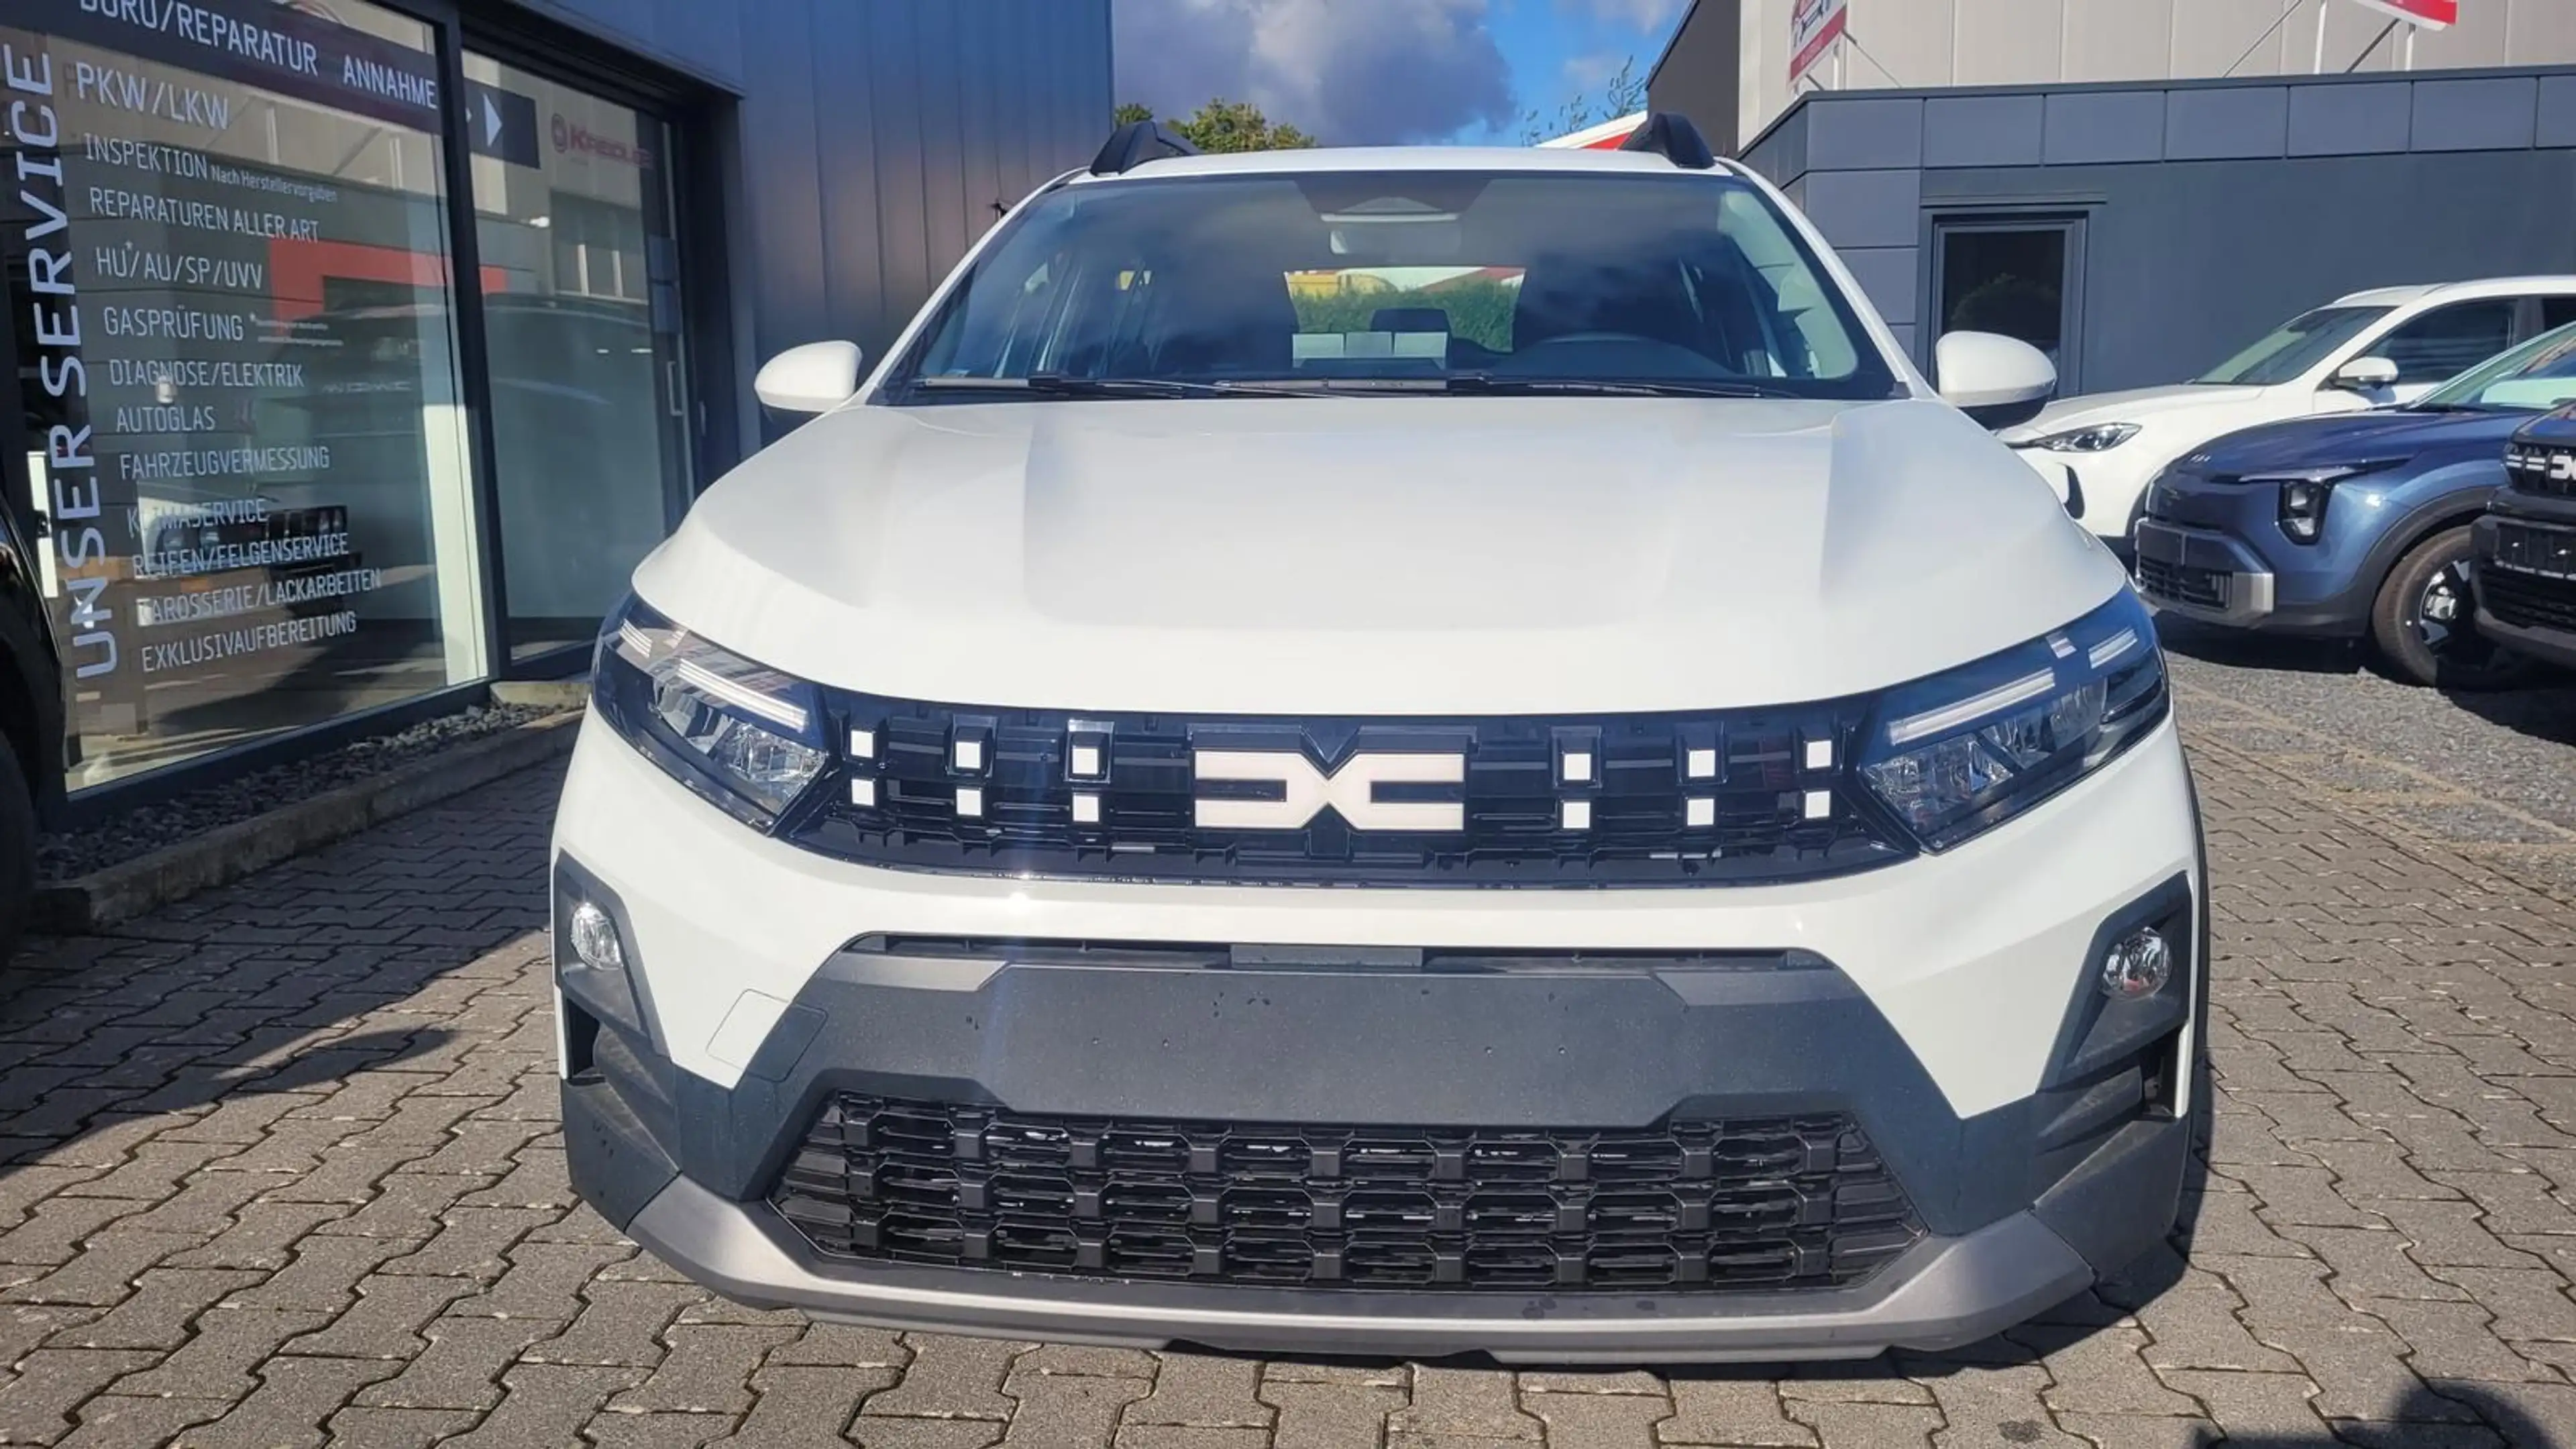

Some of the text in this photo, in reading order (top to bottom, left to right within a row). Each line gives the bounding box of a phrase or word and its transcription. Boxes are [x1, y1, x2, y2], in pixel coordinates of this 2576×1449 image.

[76, 61, 229, 130] PKW/LKW
[343, 53, 439, 111] ANNAHME
[83, 132, 207, 180] INSPEKTION
[211, 164, 240, 186] Nach
[2, 43, 87, 397] SERVICE
[90, 186, 319, 244] REPARATUREN ALLER ART
[104, 304, 244, 341] GASPRÜFUNG
[109, 358, 305, 387] DIAGNOSE/ELEKTRIK
[115, 406, 216, 433] AUTOGLAS
[119, 446, 331, 480] FAHRZEUGVERMESSUNG
[49, 424, 117, 678] UNSER
[132, 532, 349, 578] REIFEN/FELGENSERVICE
[142, 610, 356, 672] EXKLUSIVAUFBEREITUNG
